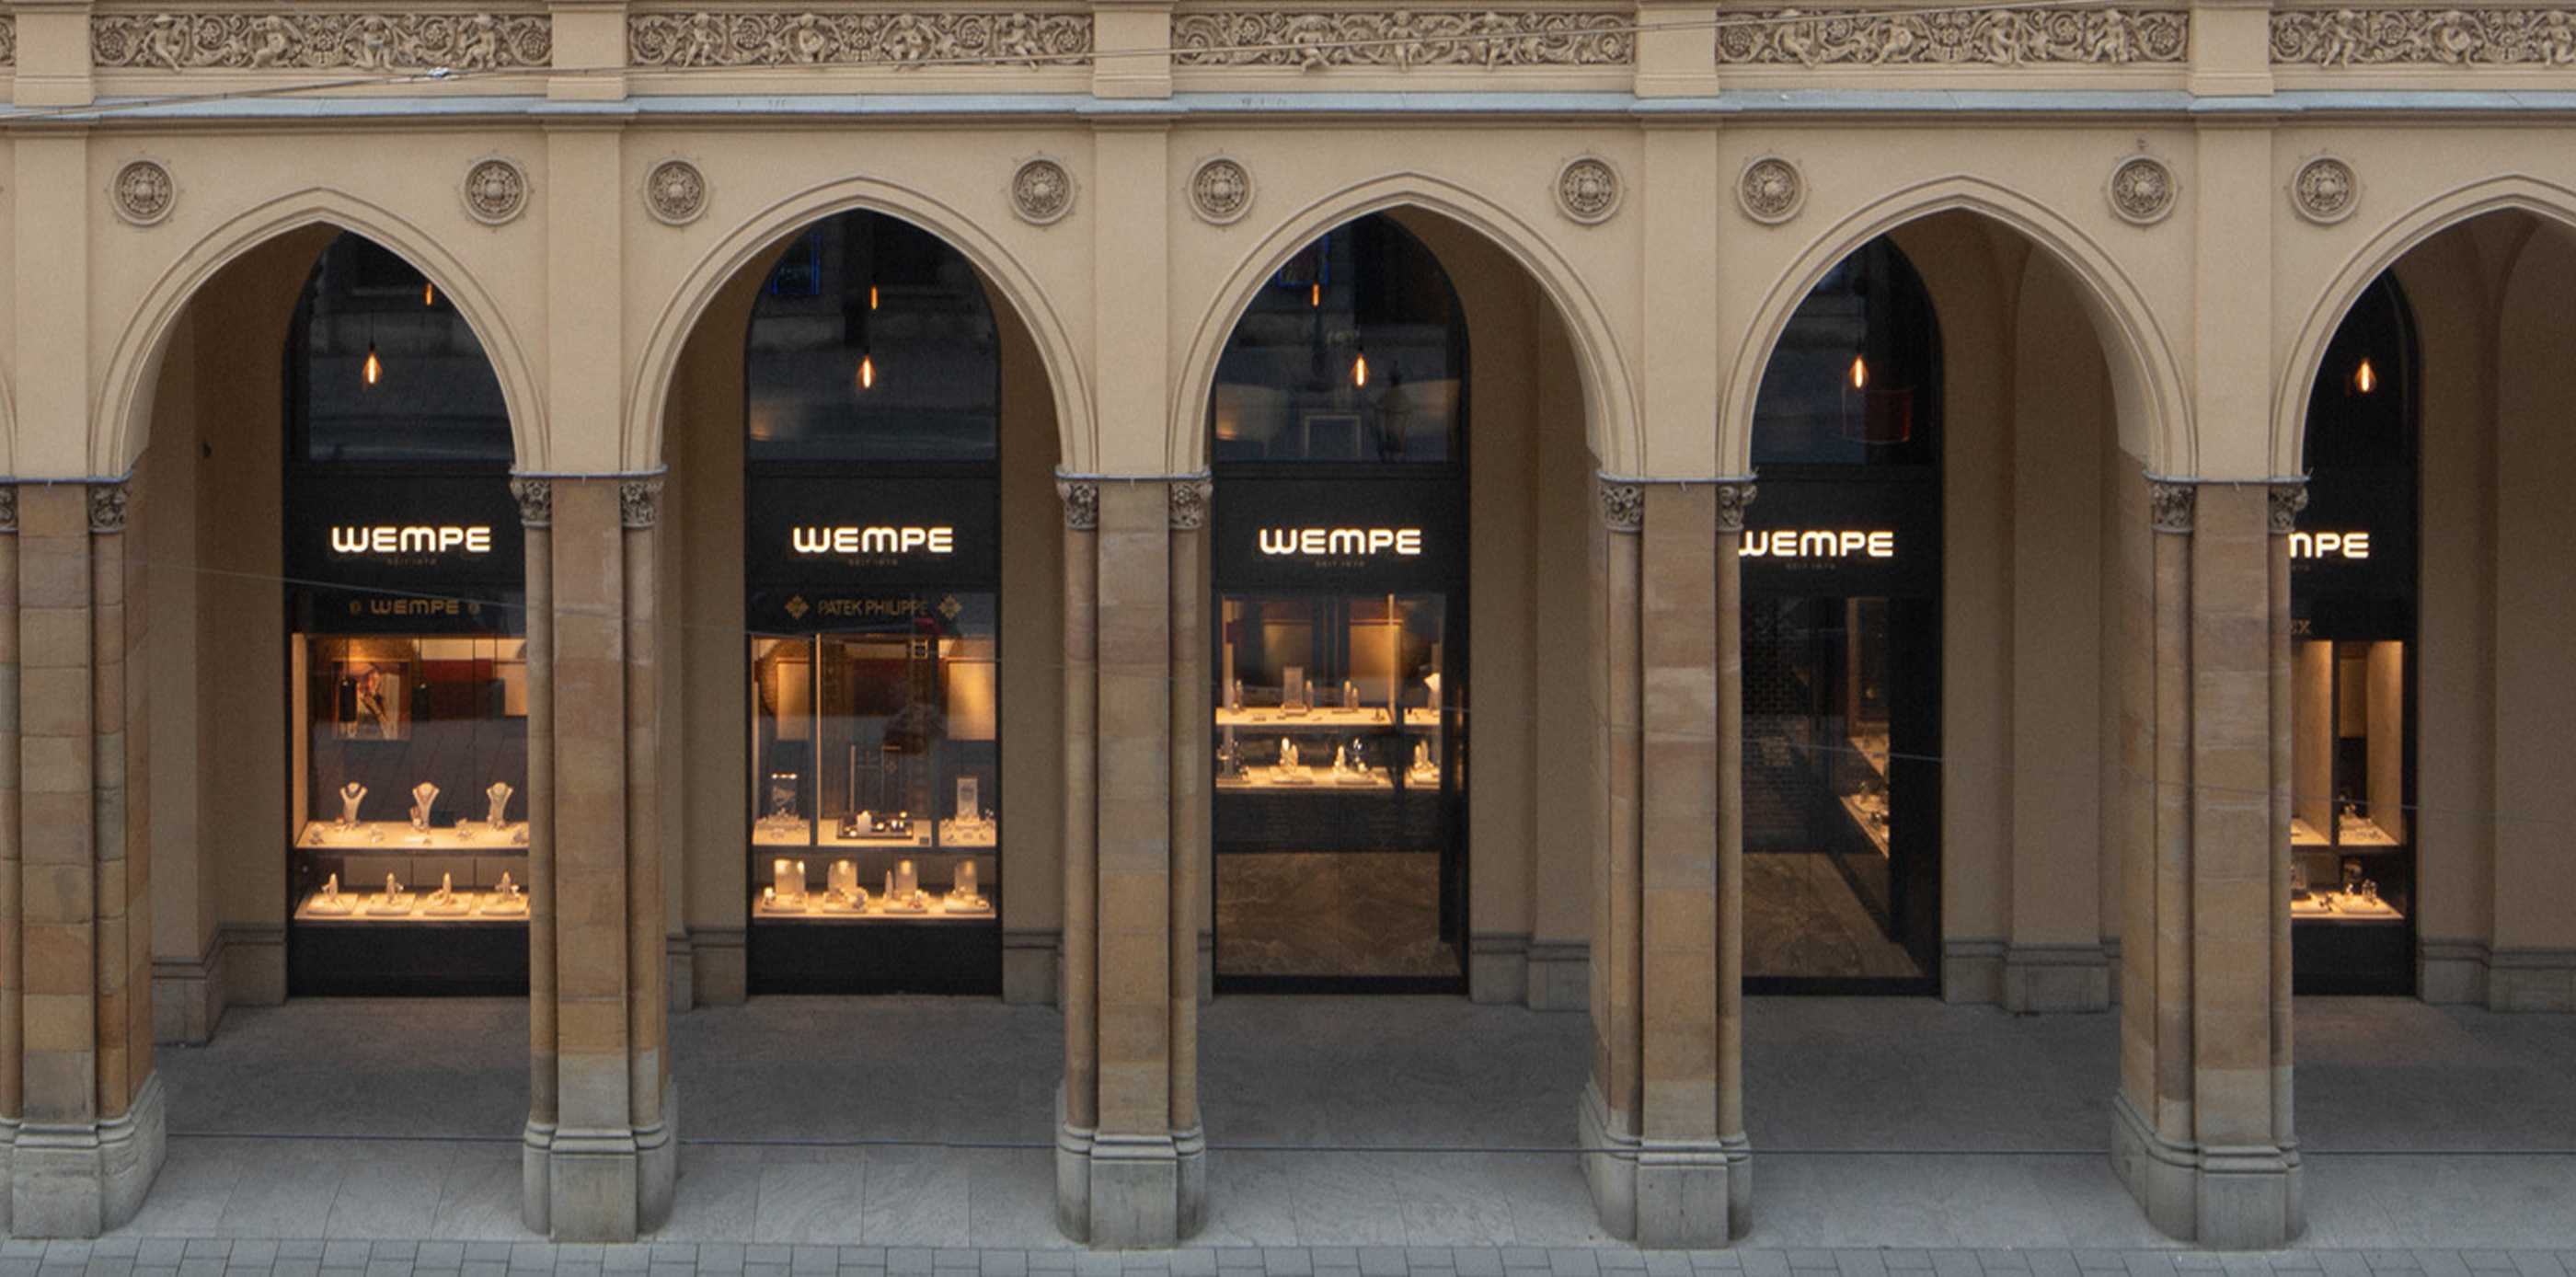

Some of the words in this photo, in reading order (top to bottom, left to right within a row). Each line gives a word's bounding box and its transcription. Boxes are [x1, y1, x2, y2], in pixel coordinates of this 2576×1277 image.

[331, 525, 491, 553] WEMPE
[792, 525, 953, 554] WEMPE
[1259, 528, 1421, 555] WEMPE
[1738, 530, 1893, 558] WEMPE
[371, 599, 460, 615] WEMPE
[817, 599, 862, 615] PATEK
[865, 599, 929, 615] PHILIPPE
